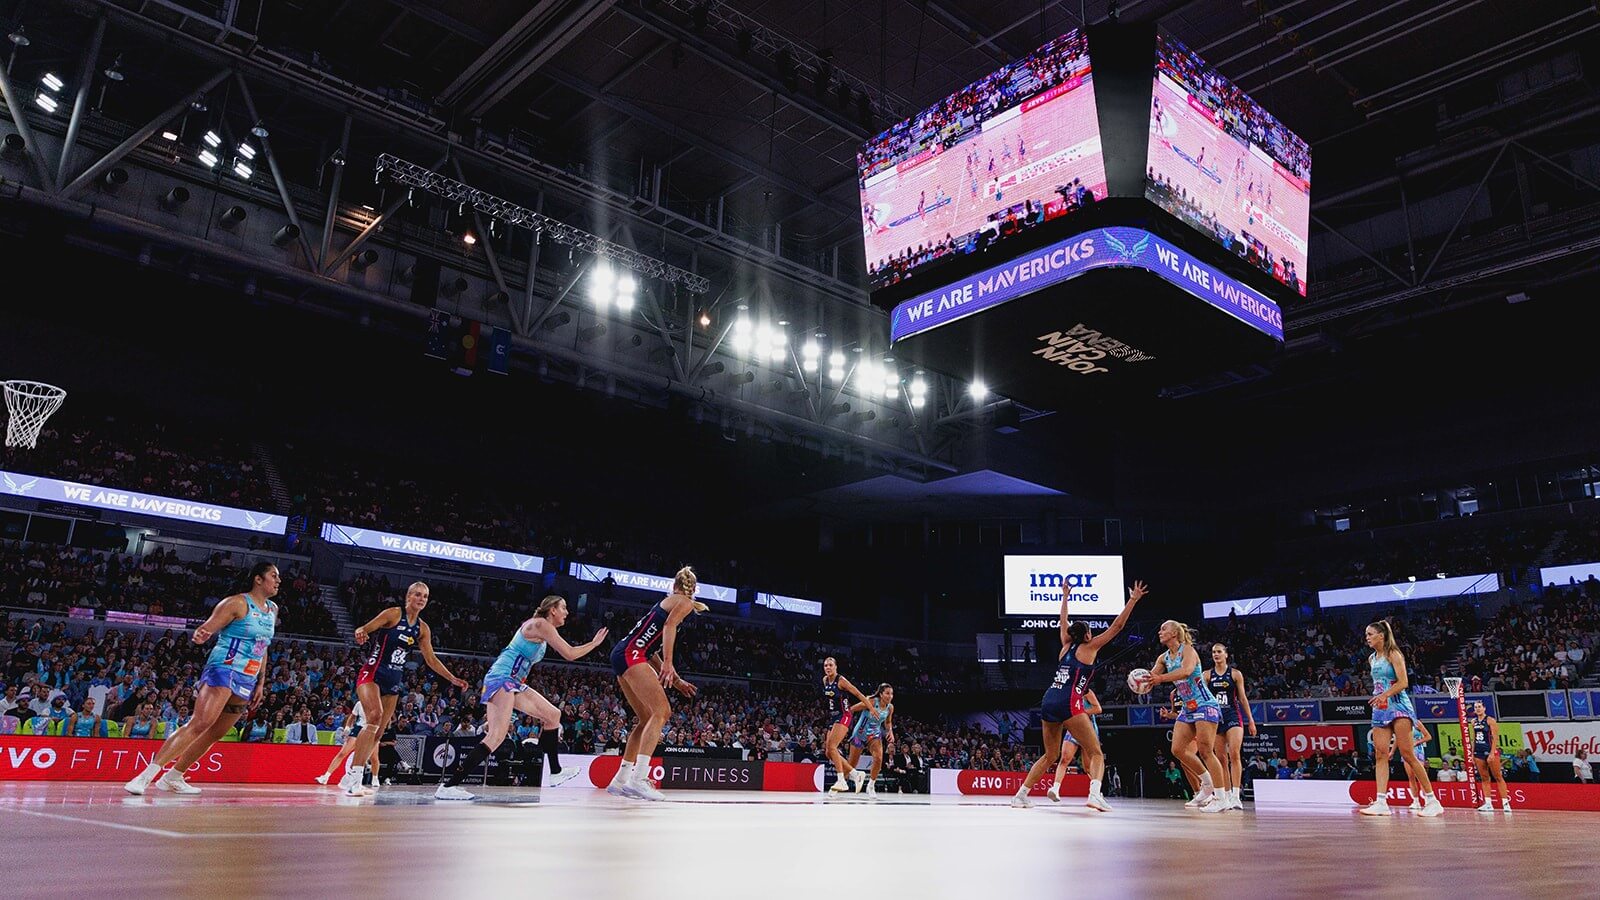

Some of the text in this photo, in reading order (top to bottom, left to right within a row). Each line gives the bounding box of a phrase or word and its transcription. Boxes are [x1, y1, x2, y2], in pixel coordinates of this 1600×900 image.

[907, 238, 1094, 323] WE ARE MAVERICKS
[1155, 243, 1282, 330] WE ARE MAVERICKS
[1036, 331, 1107, 361] CAIN
[1032, 346, 1108, 375] JOHN
[63, 485, 222, 521] WE ARE MAVERICKS
[381, 535, 495, 563] WE ARE MAVERICKS
[614, 572, 629, 584] WE
[629, 575, 649, 587] ARE
[1030, 590, 1099, 602] insurance
[642, 623, 658, 642] HCF
[1021, 619, 1048, 629] JOHN
[632, 649, 640, 661] 2
[362, 671, 369, 681] 7
[1074, 698, 1081, 711] 4
[1459, 687, 1468, 724] NISSAN
[1310, 735, 1349, 751] HCF
[1463, 726, 1473, 763] NISSAN
[671, 765, 750, 783] FITNESS
[971, 776, 1053, 791] REVO FITESS
[1468, 766, 1478, 804] NISSAN
